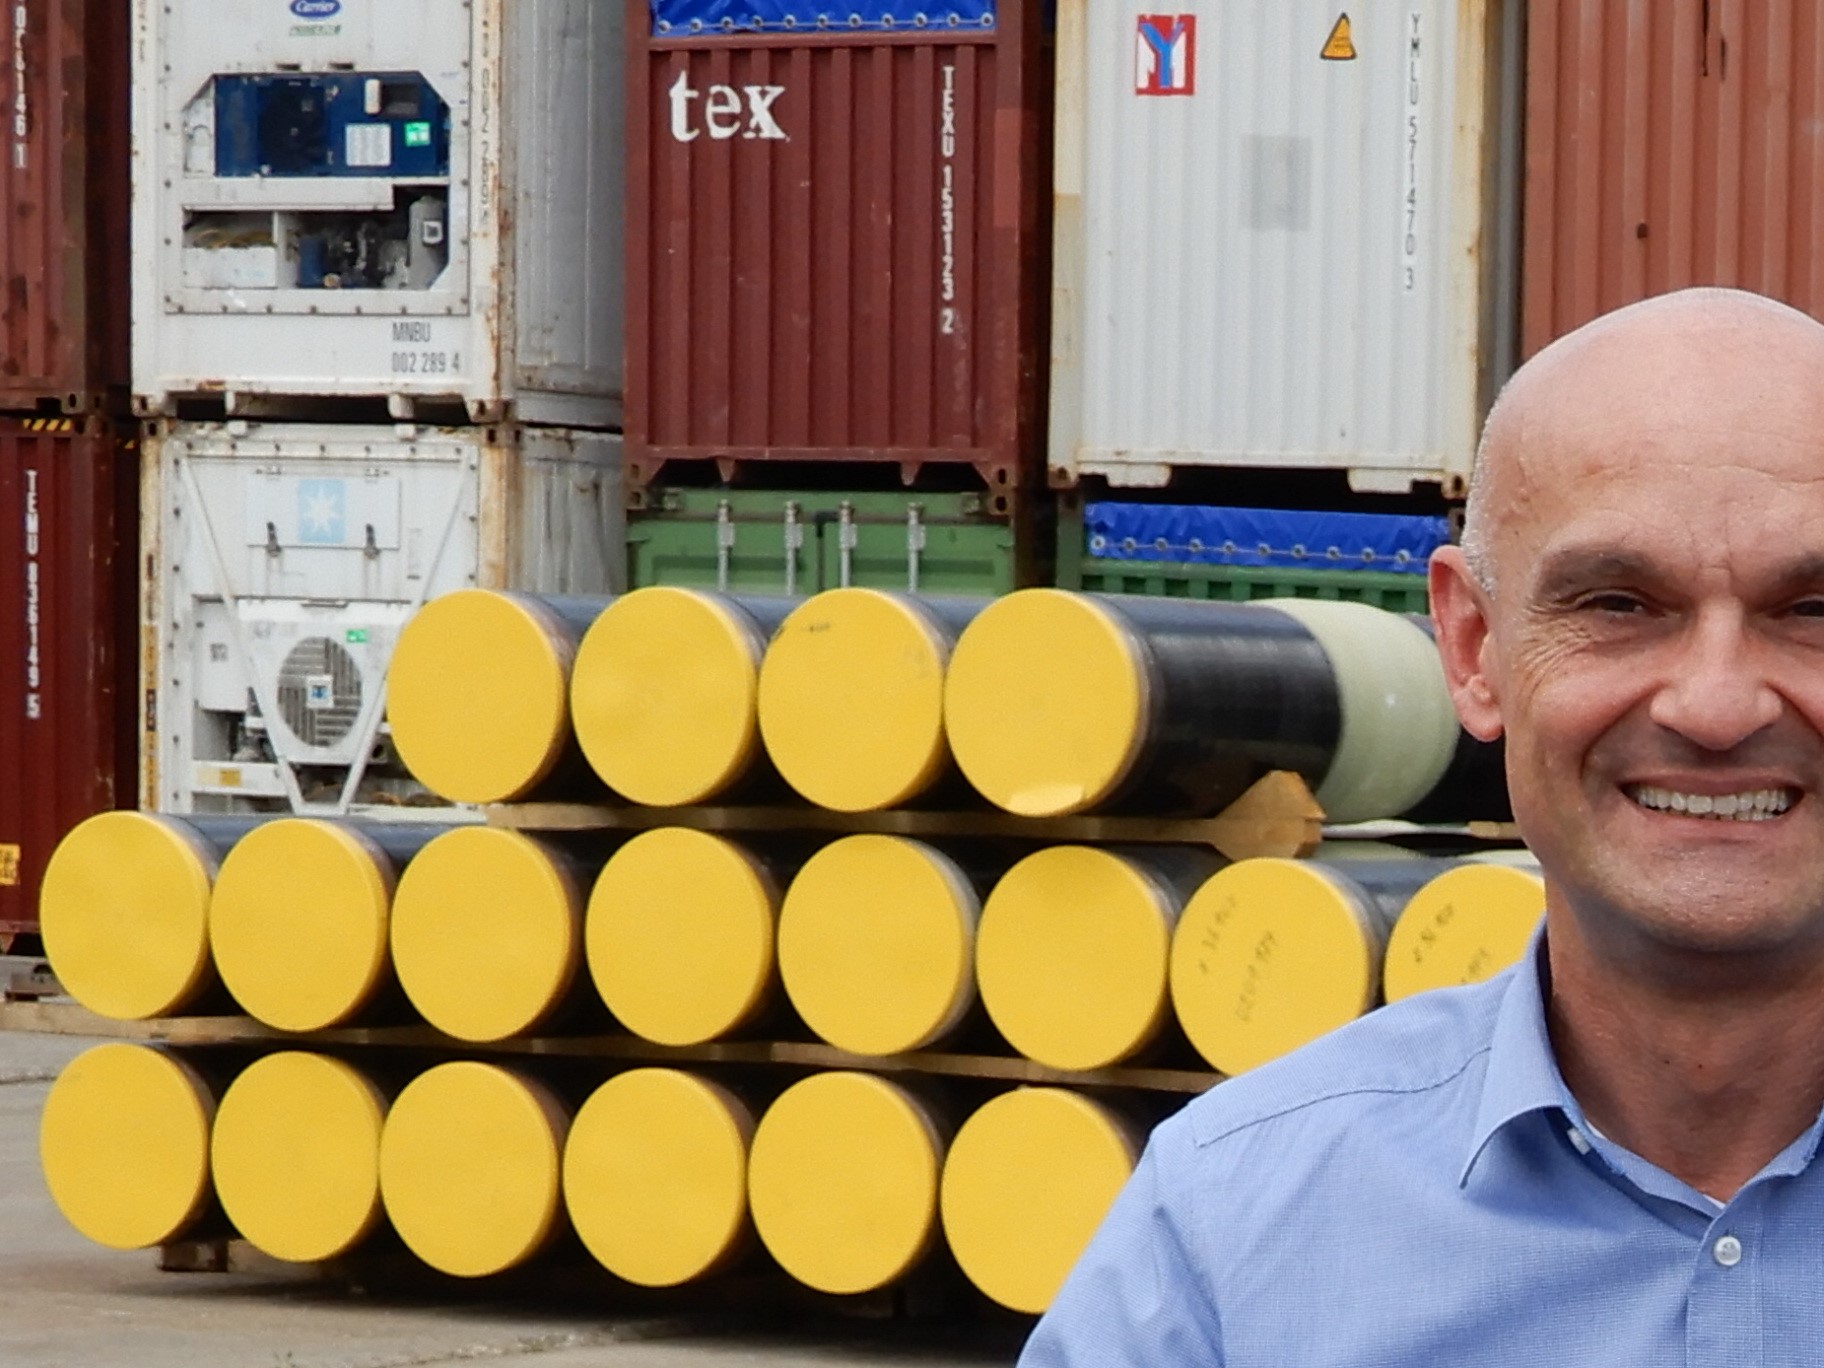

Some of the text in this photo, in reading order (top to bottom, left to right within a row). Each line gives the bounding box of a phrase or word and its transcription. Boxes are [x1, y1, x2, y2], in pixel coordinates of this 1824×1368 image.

[668, 70, 787, 142] tex
[1405, 13, 1421, 290] YMLU 571470 3
[940, 66, 956, 334] TEXU 153123 2
[392, 321, 431, 342] MNBU
[392, 351, 460, 373] 002 289 4
